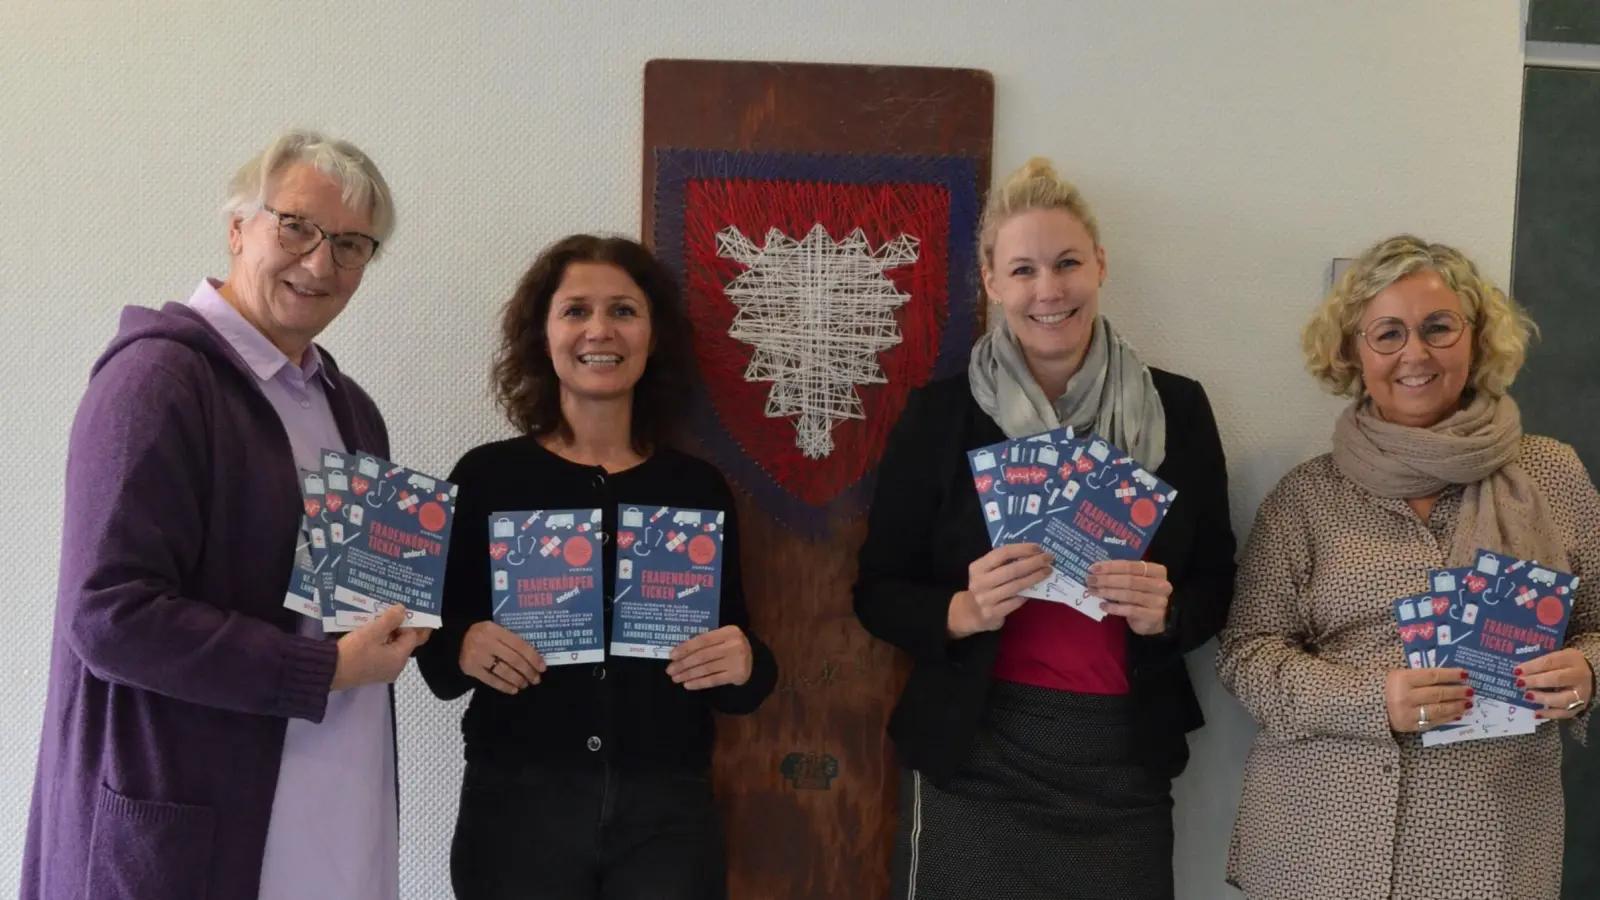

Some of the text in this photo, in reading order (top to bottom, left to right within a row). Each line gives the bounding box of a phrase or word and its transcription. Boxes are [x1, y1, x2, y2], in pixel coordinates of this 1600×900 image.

[1072, 511, 1104, 540] TICKEN
[1079, 499, 1143, 550] FRAUENKÖRPER
[368, 536, 401, 558] TICKEN
[370, 520, 442, 556] FRAUENKÖRPER
[389, 581, 404, 593] 2024,
[517, 575, 594, 592] FRAUENKÖRPER
[641, 569, 714, 587] FRAUENKÖRPER
[347, 576, 375, 591] LANDKREIS
[376, 586, 411, 603] SCHAUMBURG
[416, 598, 430, 608] SAAL
[518, 593, 553, 608] TICKEN
[641, 585, 675, 599] TICKEN
[623, 631, 652, 639] LANDKREIS
[667, 624, 682, 633] 2024,
[1484, 618, 1556, 650] FRAUENKÖRPER
[537, 639, 573, 648] SCHAUMBURG
[1480, 632, 1514, 655] TICKEN
